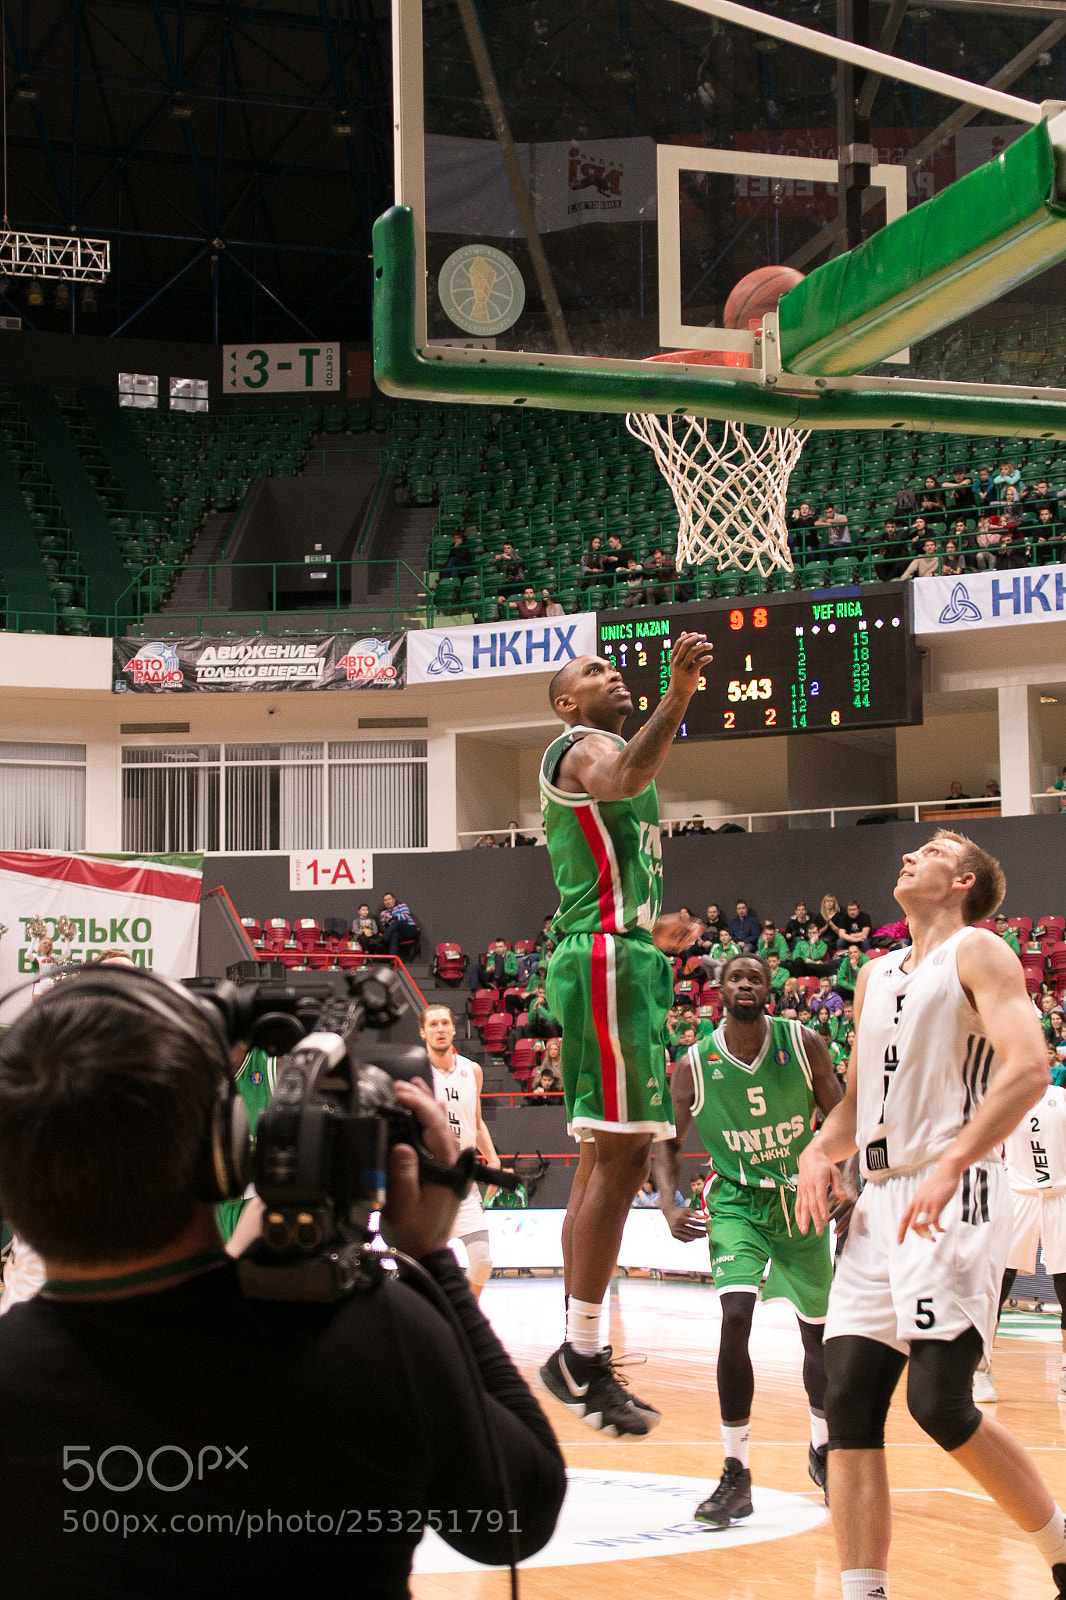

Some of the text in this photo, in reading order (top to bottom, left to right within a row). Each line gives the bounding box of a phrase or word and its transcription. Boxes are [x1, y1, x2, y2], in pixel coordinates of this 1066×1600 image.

[324, 347, 334, 387] сектор
[729, 606, 768, 631] 9 8
[812, 601, 863, 620] VEF RIGA
[601, 619, 670, 641] UNICS KAZAN
[798, 637, 804, 651] 1
[852, 631, 869, 646] 15
[196, 644, 318, 666] ДВИЖЕНИЕ
[472, 624, 578, 670] НКНХ
[852, 647, 870, 661] 18
[122, 657, 163, 672] АВТО
[335, 655, 376, 668] АВТО
[620, 652, 627, 668] 1
[638, 651, 648, 666] 2
[744, 653, 753, 672] 1
[134, 670, 184, 683] РАДИО
[195, 666, 257, 680] ТОЛЬКО
[347, 665, 397, 680] РАДИО
[797, 668, 807, 682] 5
[852, 662, 870, 677] 22
[697, 675, 707, 691] 2
[728, 677, 773, 702] 5:43
[791, 680, 820, 698] 11 2
[852, 678, 870, 693] 32
[638, 695, 649, 711] 3
[791, 698, 807, 713] 12
[852, 693, 871, 709] 44
[723, 707, 777, 729] 2 2
[791, 709, 841, 728] 14 8
[680, 721, 688, 737] 1
[445, 1087, 459, 1101] 14
[746, 1086, 767, 1117] 5
[1030, 1117, 1041, 1133] 2
[722, 1114, 805, 1153] UNICS
[760, 1146, 791, 1162] НКНХ
[1030, 1140, 1051, 1183] VEF
[915, 1297, 936, 1330] 5
